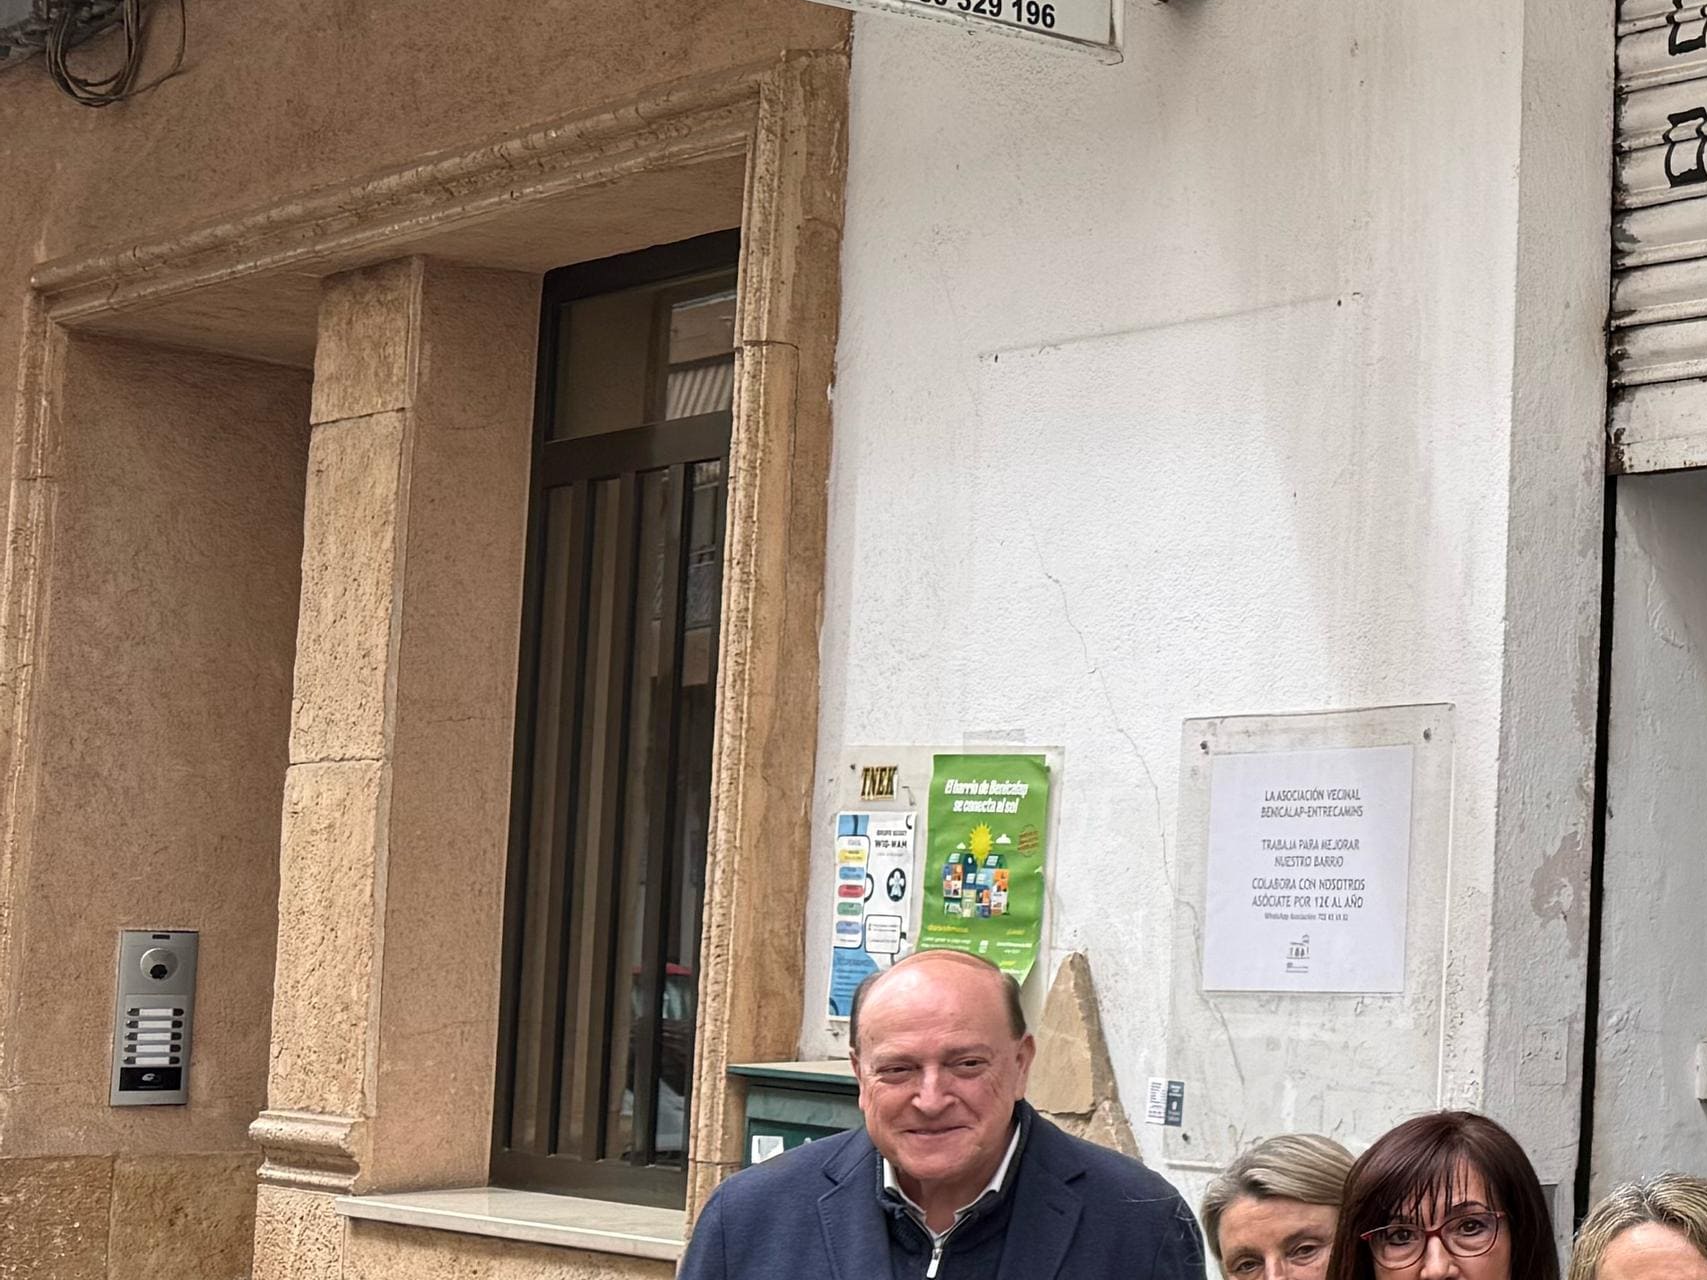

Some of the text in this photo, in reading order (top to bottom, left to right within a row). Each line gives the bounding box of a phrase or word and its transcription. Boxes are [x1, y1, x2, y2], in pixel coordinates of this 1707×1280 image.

[1264, 787, 1361, 802] LA ASOCIACIÓN VECINAL
[1262, 838, 1360, 851] TRABAJA PARA MEJORAR
[1274, 855, 1344, 867] NUESTRO BARRIO
[1252, 877, 1366, 891] COLABORA CON NOSOTROS
[1252, 893, 1292, 908] ASÓCIATE
[1293, 896, 1312, 908] POR
[1330, 896, 1342, 909] AL
[1343, 894, 1364, 909] AÑO
